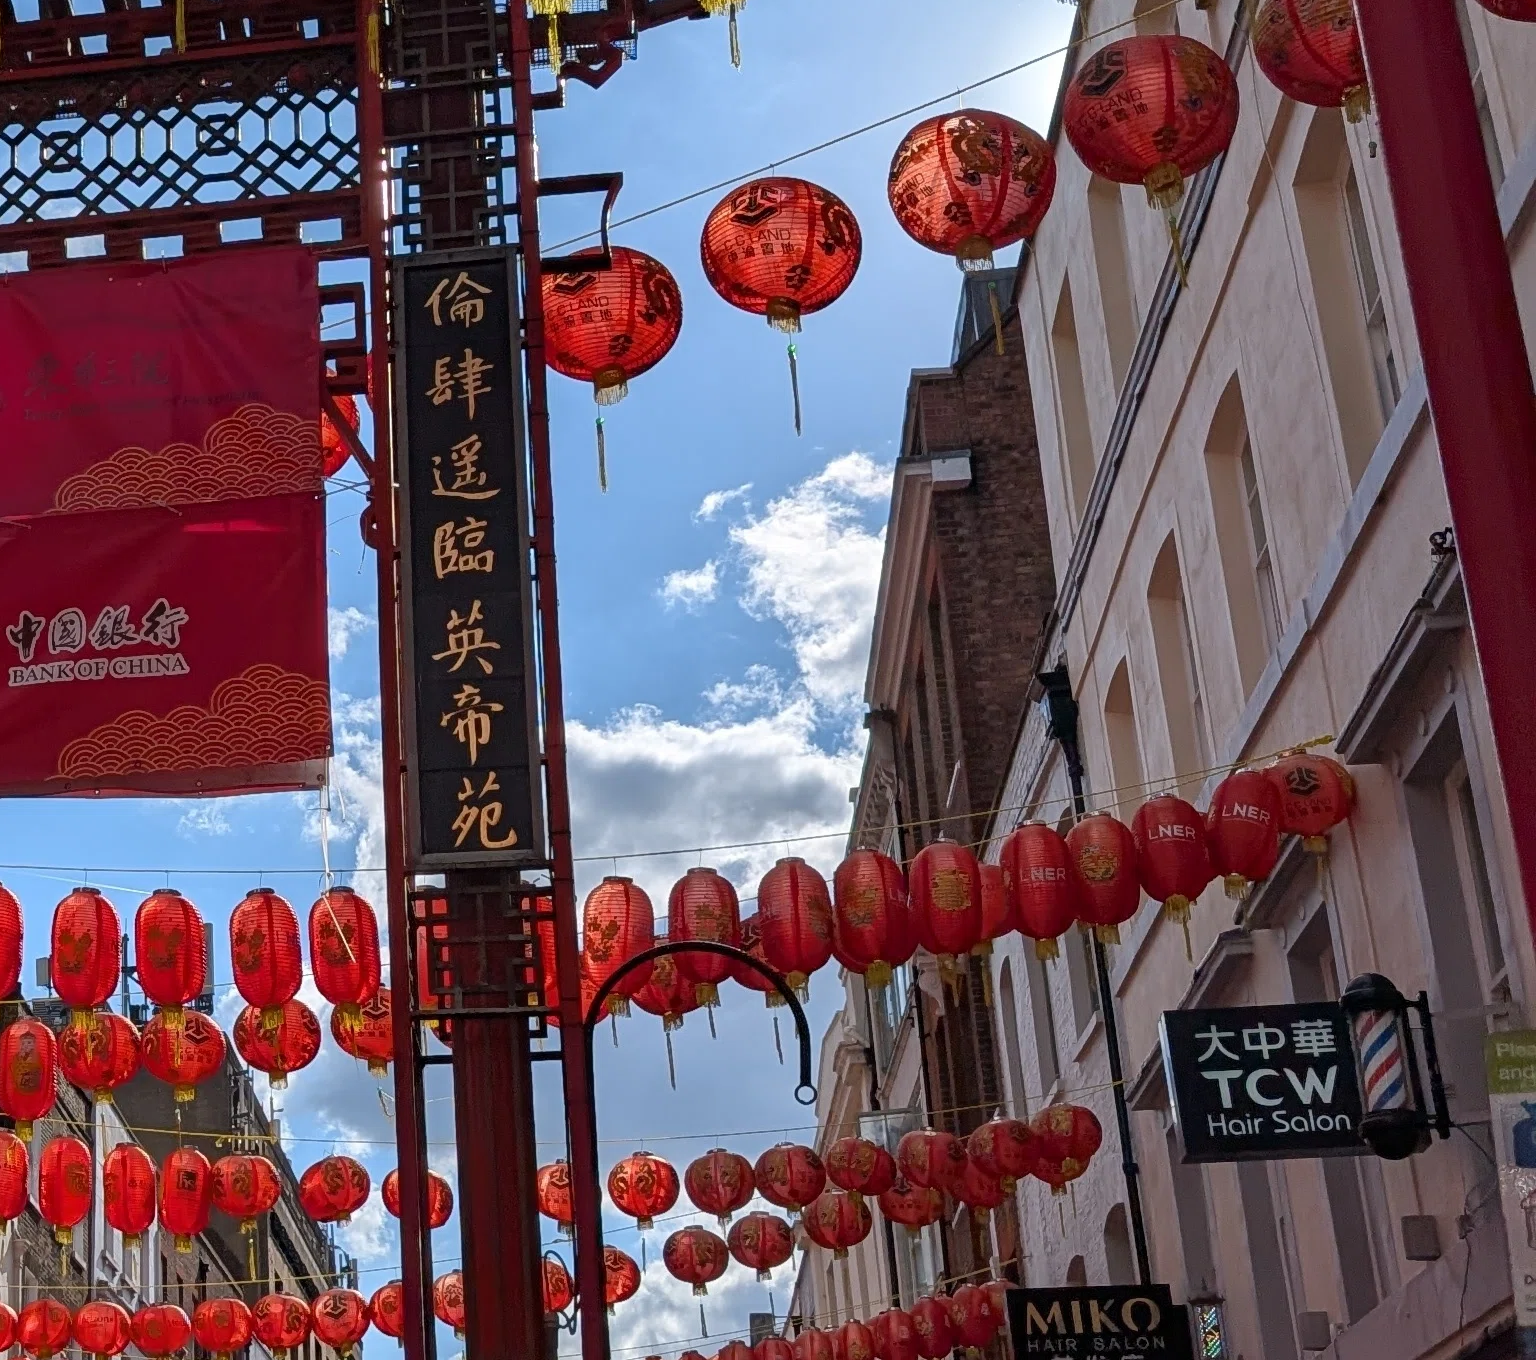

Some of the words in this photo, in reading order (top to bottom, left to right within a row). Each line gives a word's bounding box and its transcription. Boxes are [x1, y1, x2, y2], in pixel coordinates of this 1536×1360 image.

[12, 663, 73, 685] BANK
[76, 661, 107, 680] OF
[110, 654, 187, 676] CHINA
[1222, 804, 1271, 826] LNER
[1147, 824, 1195, 841] LNER
[1194, 1019, 1337, 1063] 大中華
[1200, 1064, 1338, 1109] TCW
[1207, 1113, 1265, 1137] Hair
[1271, 1108, 1352, 1134] Salon
[1026, 1297, 1161, 1335] MIKO
[1027, 1337, 1078, 1353] HAIR
[1093, 1335, 1166, 1352] SALON
